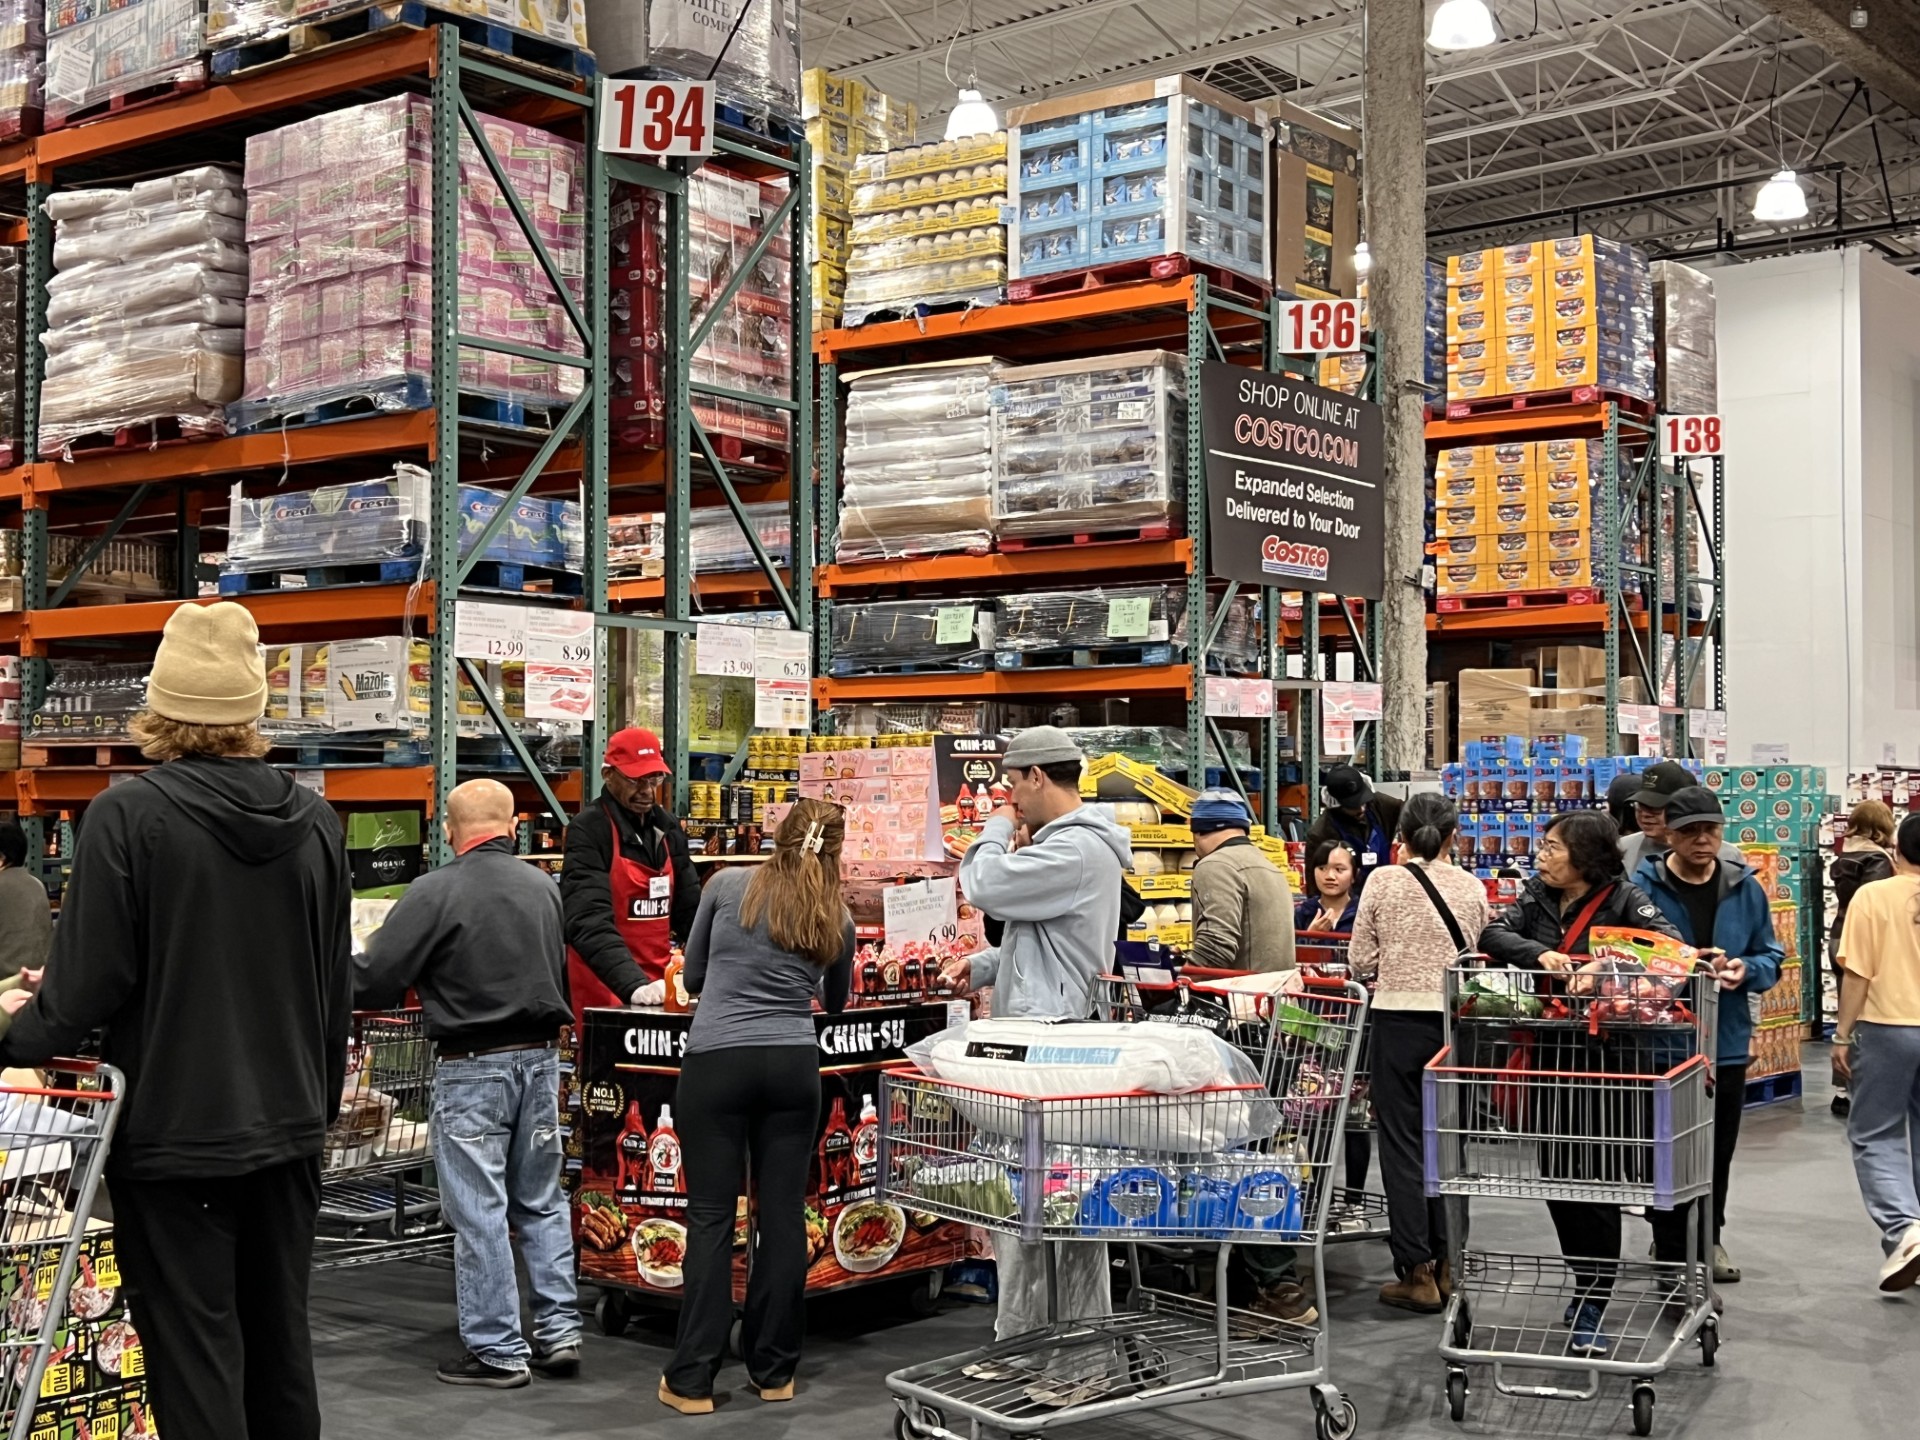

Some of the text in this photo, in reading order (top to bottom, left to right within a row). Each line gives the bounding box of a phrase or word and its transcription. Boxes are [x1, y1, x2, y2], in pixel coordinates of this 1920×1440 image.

[614, 84, 706, 153] 134
[1287, 301, 1356, 351] 136
[1100, 389, 1136, 400] WALNUTS
[1238, 379, 1361, 430] SHOP ONLINE AT
[1234, 413, 1359, 469] COSTCO.COM
[1665, 416, 1722, 454] 138
[1235, 469, 1354, 511] Expanded Selection
[275, 504, 311, 521] Crest
[348, 497, 392, 512] Crest
[471, 502, 501, 514] Cres
[518, 507, 549, 520] Crest
[1226, 497, 1361, 540] Delivered to Your Door
[1262, 535, 1329, 568] COSTCO
[487, 640, 524, 657] 12.99
[562, 645, 591, 662] 8.99
[784, 662, 806, 676] 6.79
[953, 739, 996, 751] CHIN-SU
[372, 859, 406, 869] ORGANIC
[929, 923, 957, 945] 6.99
[1652, 957, 1681, 974] GALA
[1189, 1014, 1218, 1029] CHICKEN
[820, 1020, 905, 1055] CHIN-SU
[593, 1087, 614, 1099] NO.1
[53, 1367, 68, 1392] PHO
[94, 1417, 116, 1436] PHO
